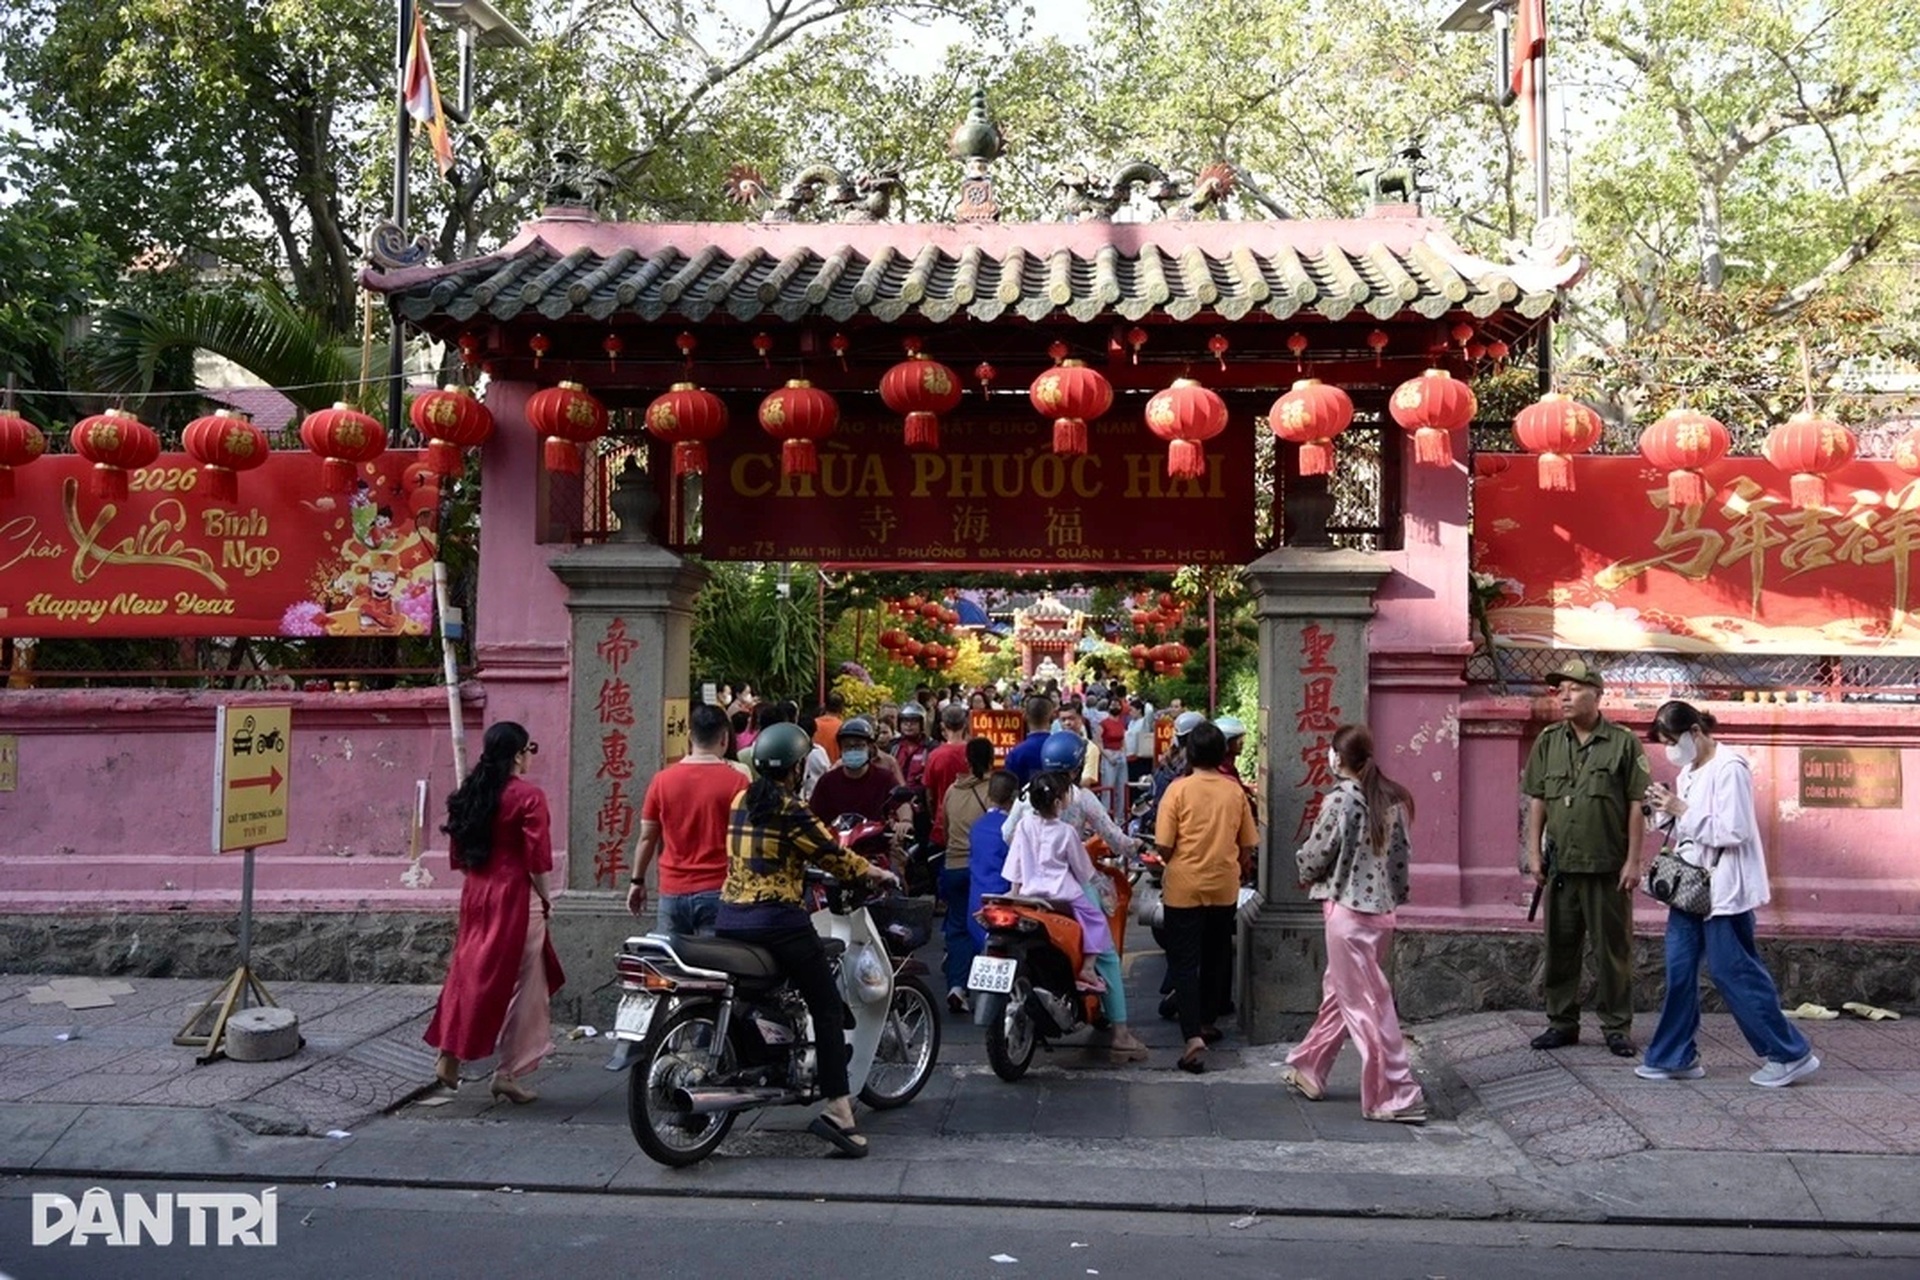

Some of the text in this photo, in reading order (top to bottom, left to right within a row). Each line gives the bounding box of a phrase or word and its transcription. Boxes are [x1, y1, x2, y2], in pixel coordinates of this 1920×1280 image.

[128, 467, 197, 492] 2026
[910, 440, 1104, 499] PHƯỚC
[201, 507, 268, 538] Bính
[0, 516, 67, 571] Chào
[221, 539, 280, 577] Ngọ
[788, 546, 813, 557] MAI
[1112, 549, 1120, 559] 1
[1141, 549, 1226, 560] TP.HCM
[26, 591, 236, 624] Happy New Year
[1001, 732, 1016, 745] XE
[1292, 622, 1342, 890] 聖恩宏
